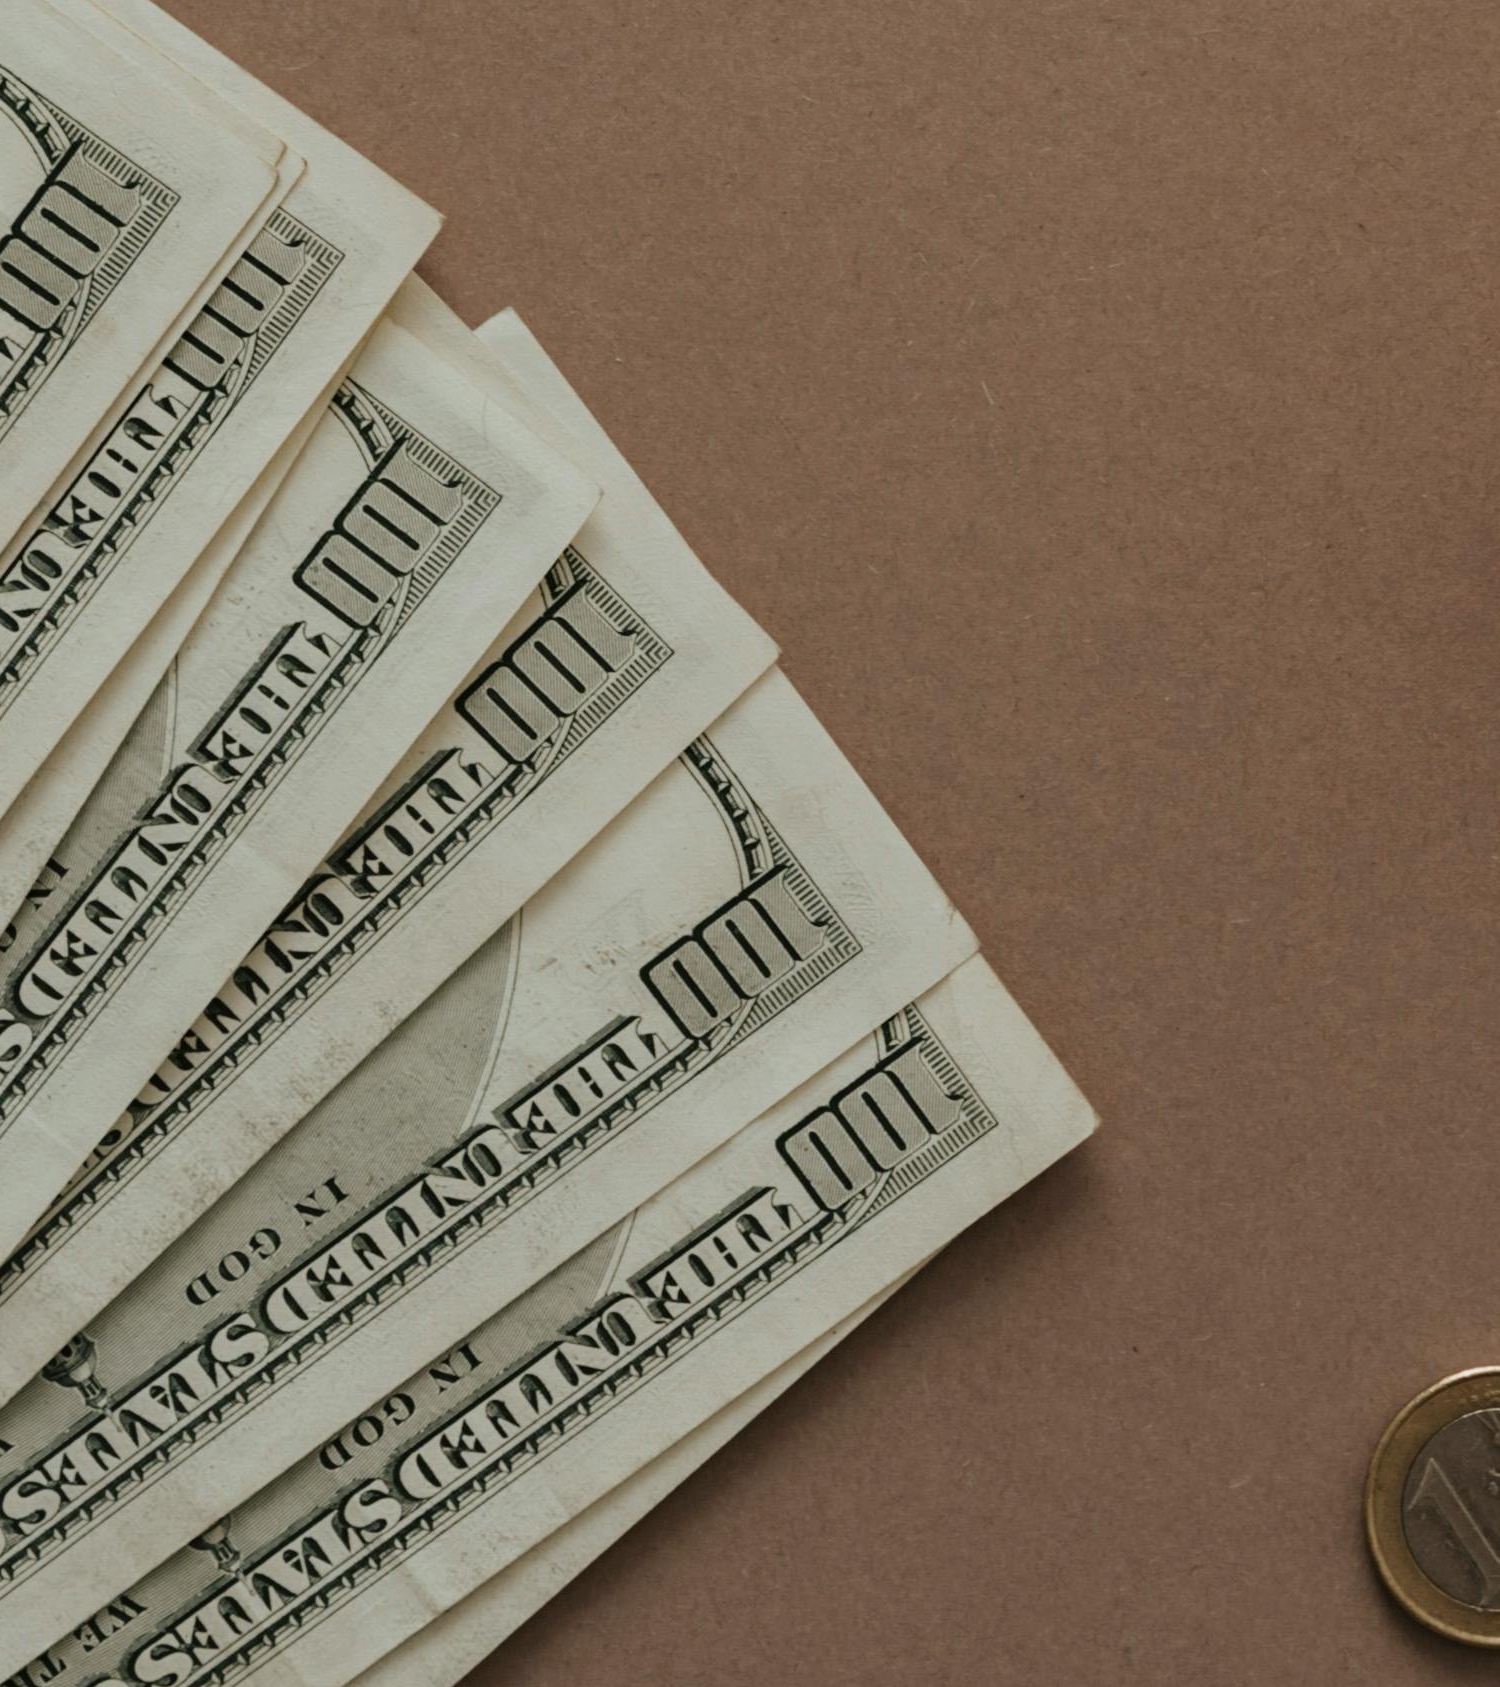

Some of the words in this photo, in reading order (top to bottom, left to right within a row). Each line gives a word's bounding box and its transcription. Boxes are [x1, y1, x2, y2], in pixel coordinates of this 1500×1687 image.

[44, 381, 188, 545] THE
[284, 439, 469, 637] 100
[187, 616, 339, 786] THE
[453, 589, 641, 765] 100
[337, 741, 497, 896] THE
[633, 861, 835, 1047] 100
[497, 1006, 669, 1155] THE
[769, 1029, 976, 1219] 100
[176, 1219, 285, 1312] GOD
[246, 1118, 524, 1347] UNITED
[284, 1171, 350, 1231] IN
[624, 1174, 805, 1332] THE
[310, 1384, 422, 1479] GOD
[376, 1279, 664, 1517] UNITED
[421, 1339, 483, 1396] IN
[69, 1586, 147, 1654] WE
[121, 1474, 408, 1687] STATES
